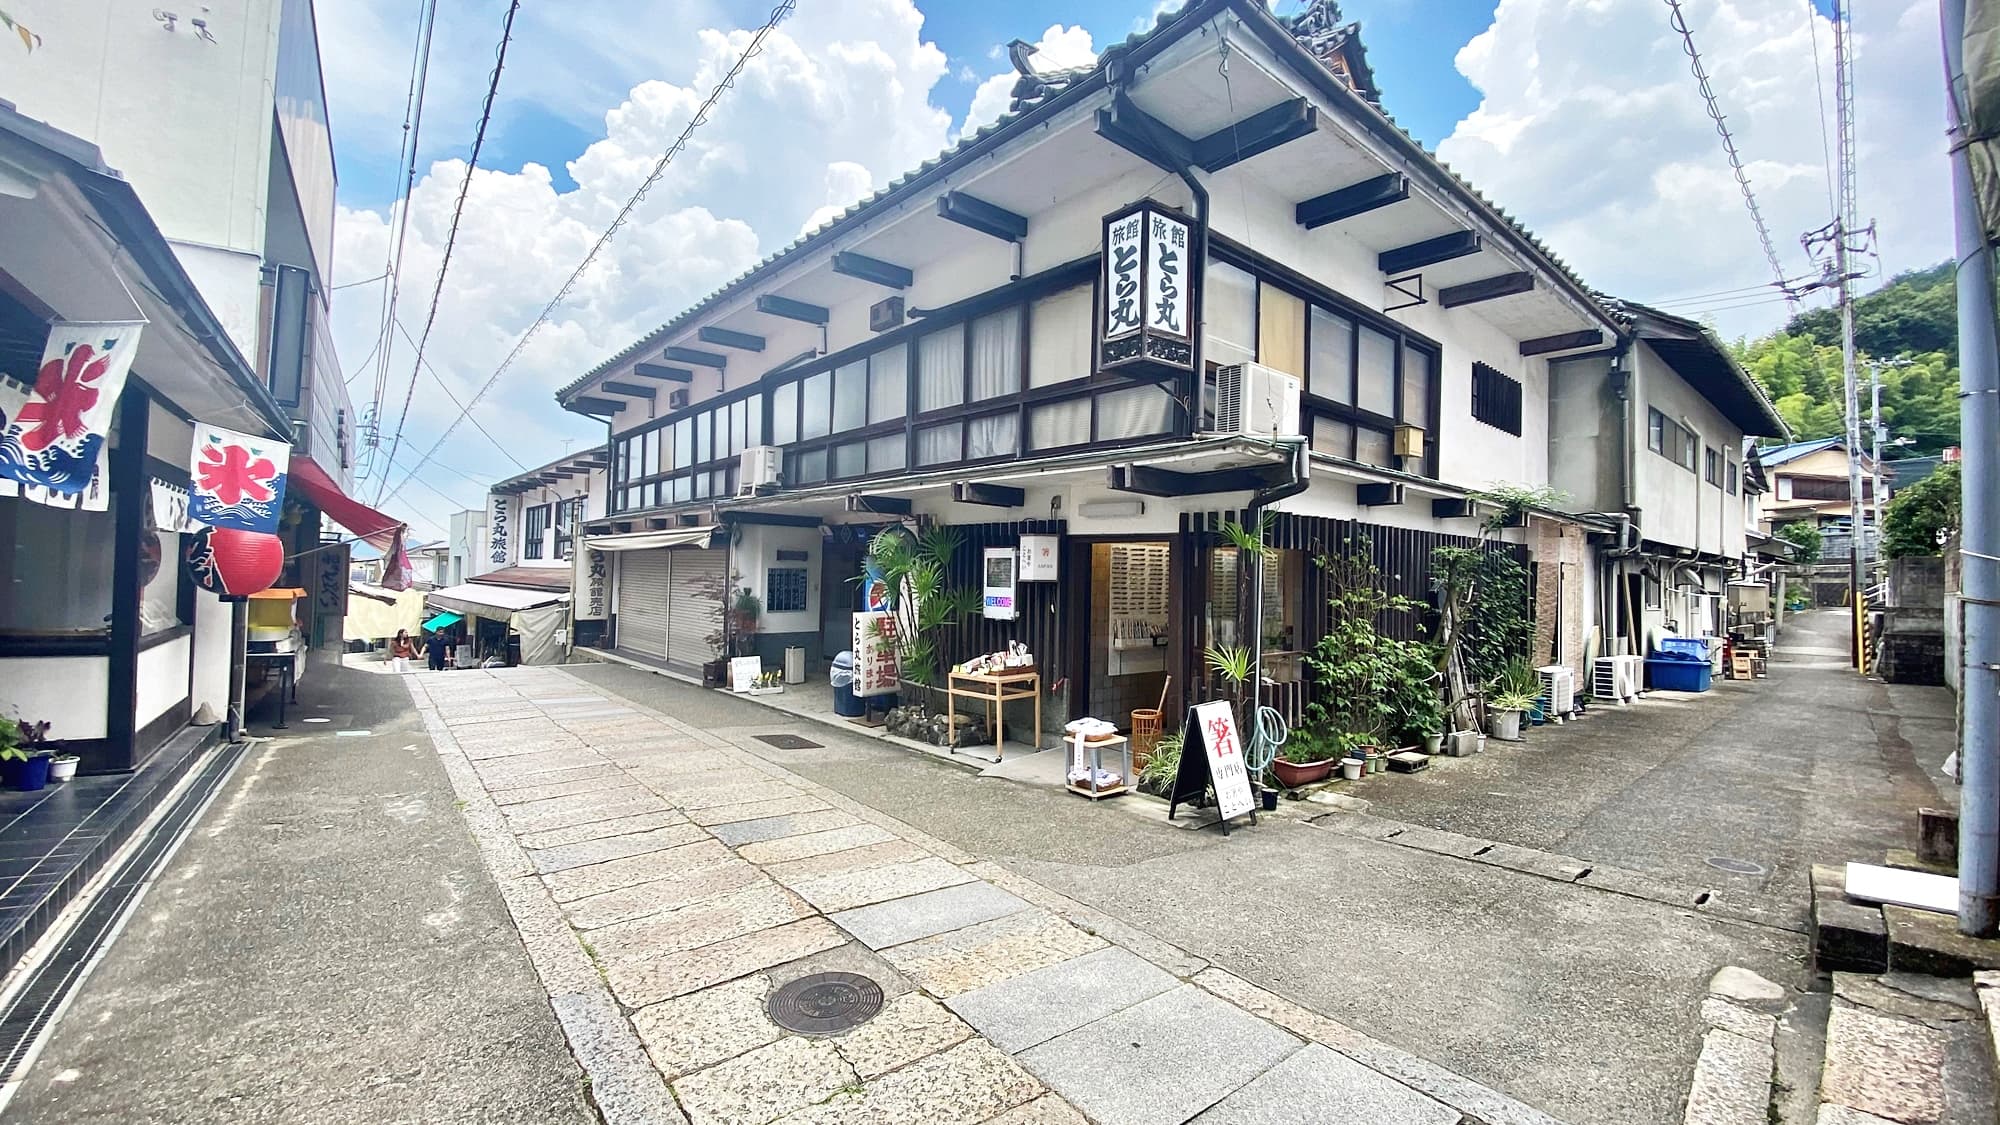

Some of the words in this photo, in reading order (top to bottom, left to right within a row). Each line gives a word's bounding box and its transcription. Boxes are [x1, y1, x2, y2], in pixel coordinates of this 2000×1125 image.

[1112, 218, 1139, 248] 旅館
[1152, 217, 1185, 249] 旅館
[1109, 245, 1140, 333] とら丸
[1154, 242, 1180, 332] とら丸
[16, 343, 111, 451] 氷
[198, 444, 276, 506] 氷
[490, 499, 508, 564] とら丸旅館
[854, 617, 862, 692] とら丸旅館
[866, 643, 874, 690] あります
[1208, 717, 1233, 758] 箸
[1215, 762, 1243, 780] 専門店
